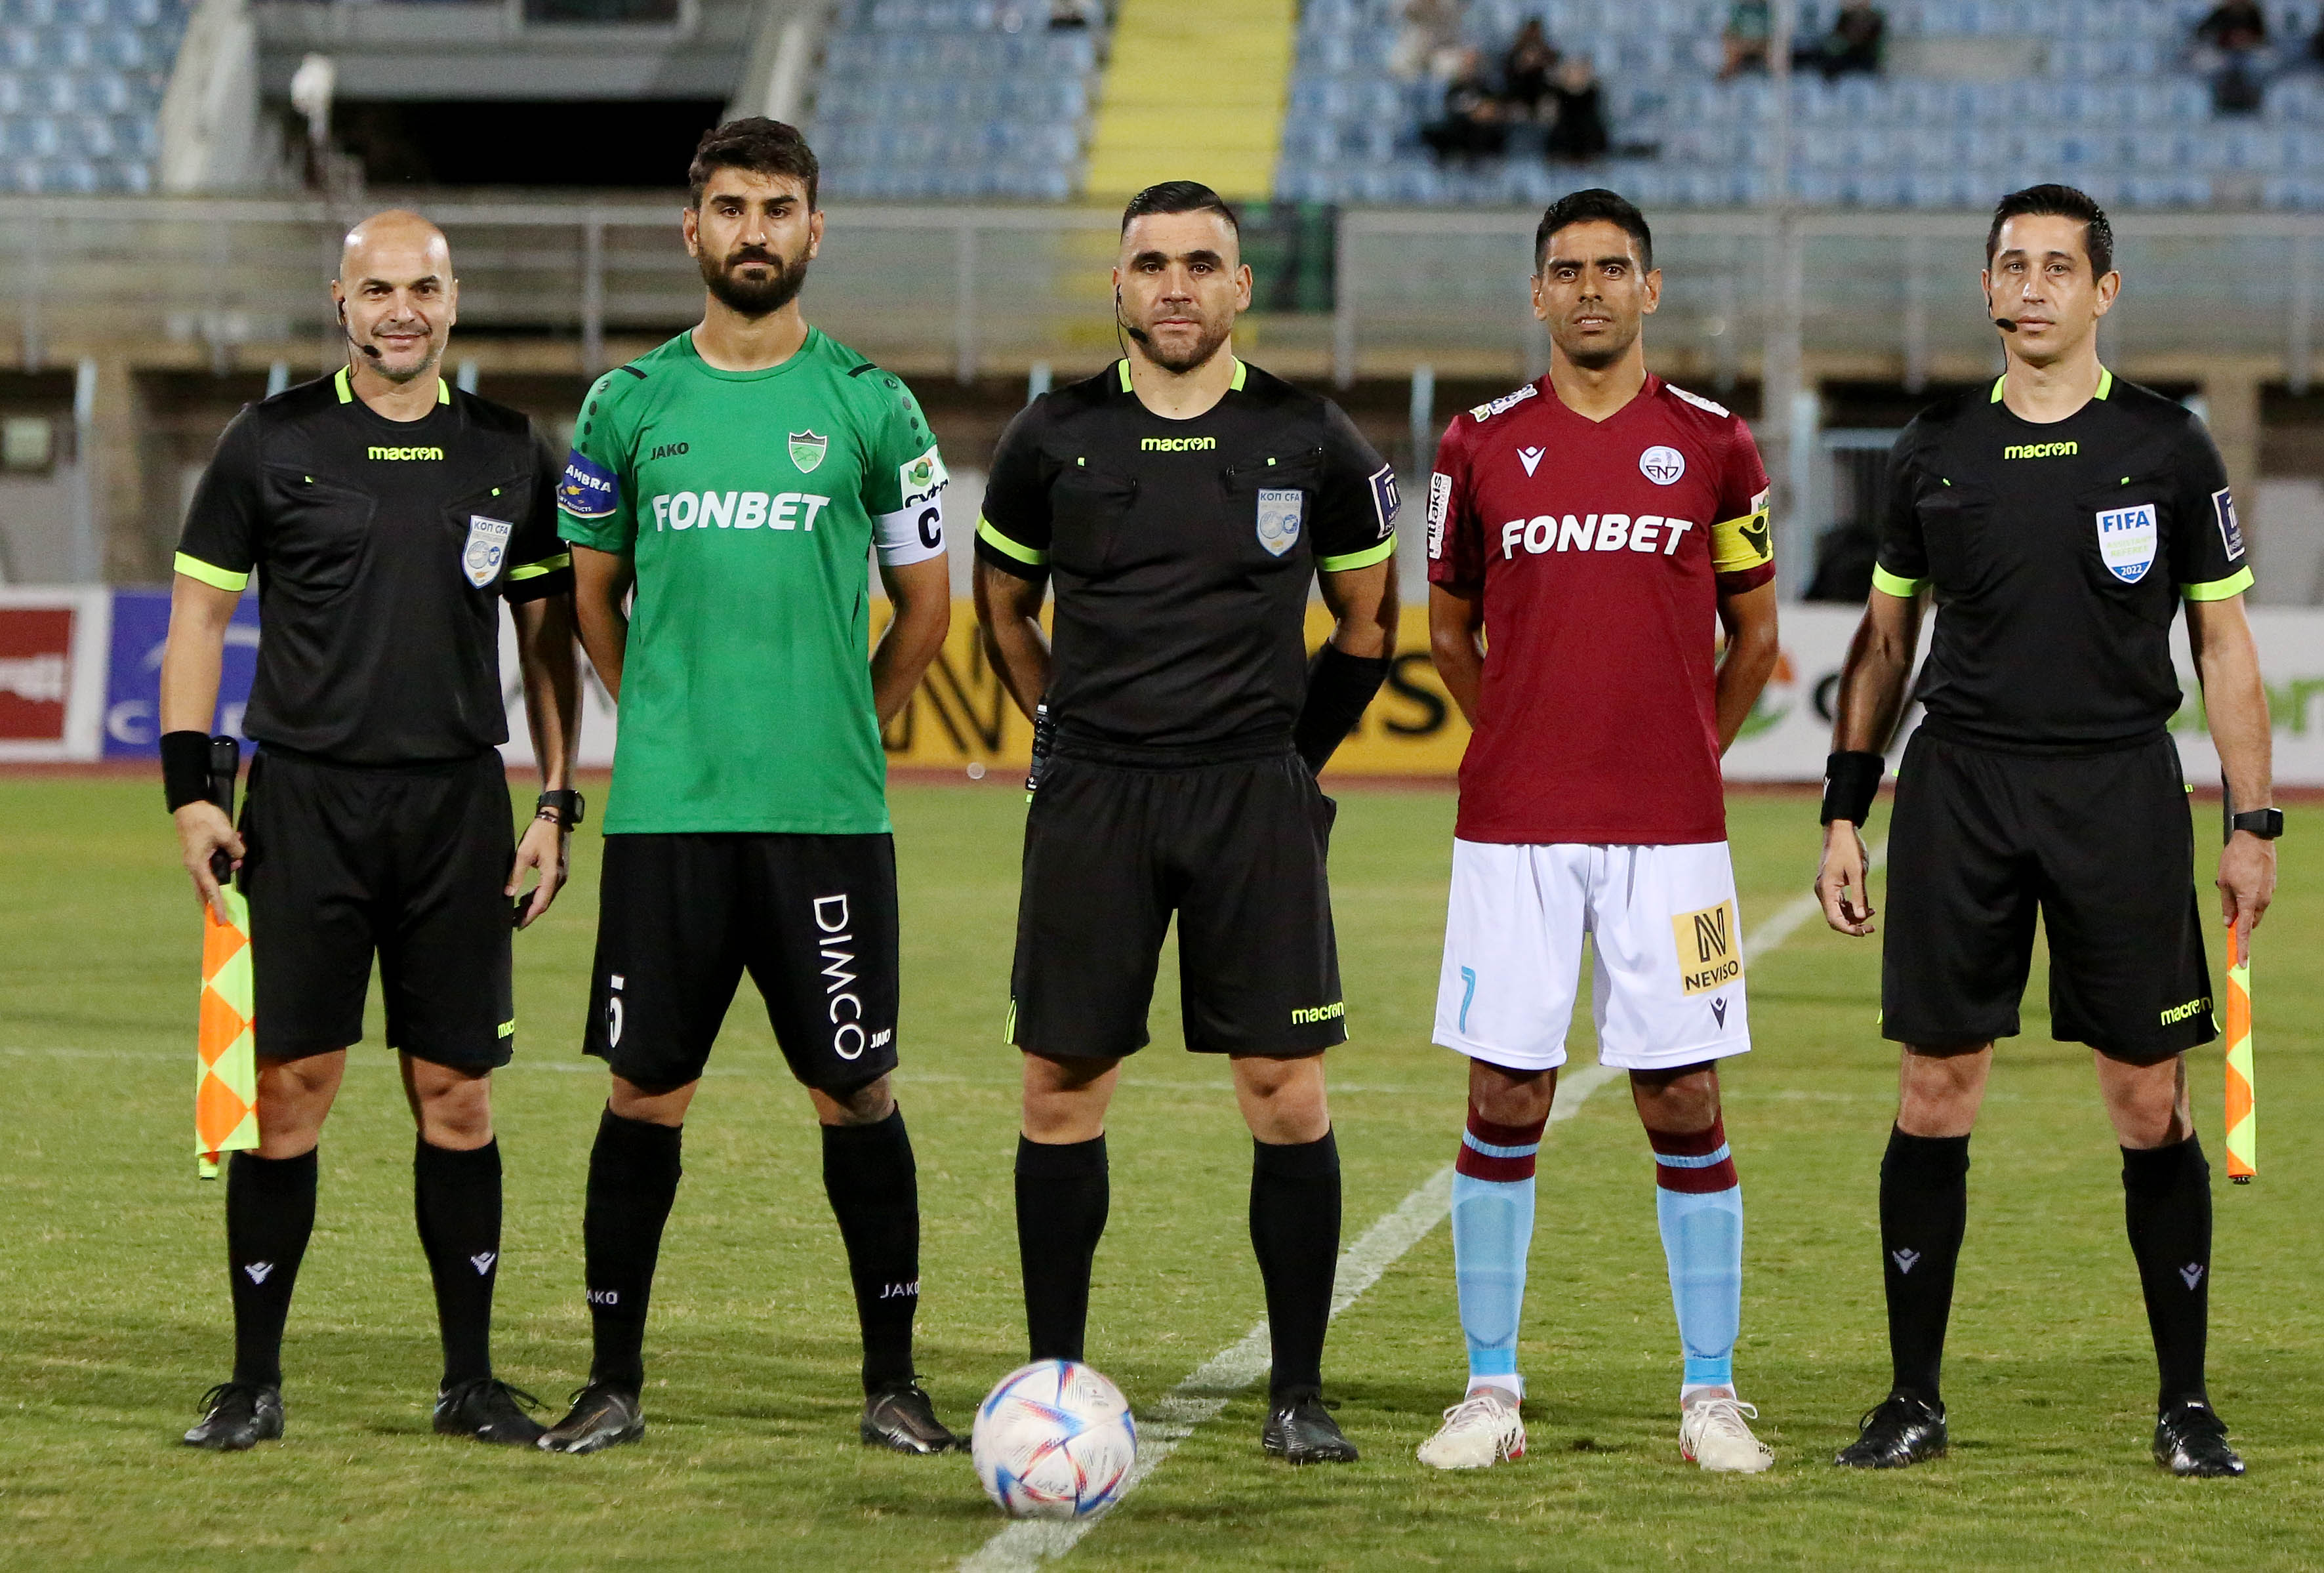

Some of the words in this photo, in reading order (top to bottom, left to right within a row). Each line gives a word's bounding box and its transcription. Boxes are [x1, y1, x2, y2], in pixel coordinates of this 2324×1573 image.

[368, 447, 443, 460] macron
[650, 442, 689, 460] JAKO
[1141, 437, 1215, 452] macron
[2005, 441, 2078, 459] macron
[565, 464, 611, 493] AMBRA
[1284, 493, 1300, 502] CFA
[652, 491, 831, 532] FONBET
[2102, 510, 2150, 533] FIFA
[495, 525, 509, 535] CFA
[918, 506, 941, 549] C
[1502, 514, 1693, 560] FONBET
[2120, 564, 2143, 577] 2022
[813, 894, 865, 1060] DIMCO
[1684, 960, 1739, 991] NEVISO
[1459, 965, 1477, 1034] 7
[2161, 996, 2212, 1026] macron
[1292, 1002, 1344, 1025] macron
[586, 1290, 618, 1304] AKO
[880, 1282, 919, 1298] JAKO
